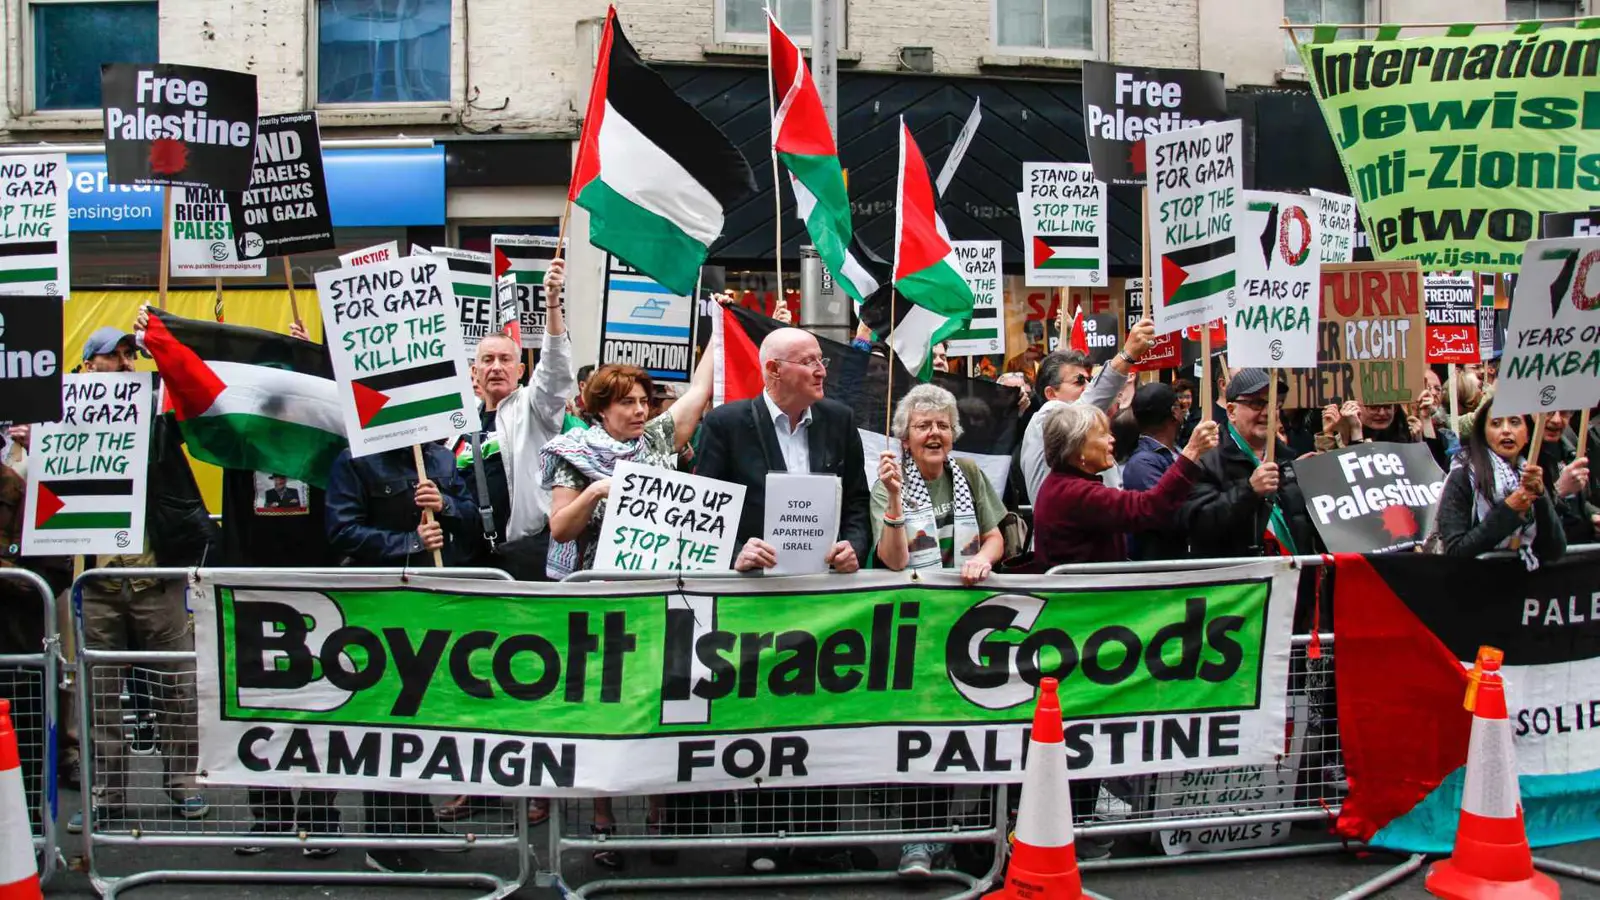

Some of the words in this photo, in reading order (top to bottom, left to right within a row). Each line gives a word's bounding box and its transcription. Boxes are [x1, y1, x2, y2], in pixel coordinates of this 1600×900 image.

[137, 71, 208, 106] Free
[1116, 72, 1182, 109] Free
[107, 108, 250, 147] Palestine
[280, 114, 312, 123] Campaign
[255, 130, 302, 164] ND
[1155, 137, 1211, 167] STAND
[1216, 132, 1234, 153] UP
[34, 162, 57, 178] UP
[1031, 169, 1077, 183] STAND
[1156, 166, 1190, 194] FOR
[1195, 156, 1234, 184] GAZA
[6, 181, 57, 198] GAZA
[185, 188, 224, 203] MAK
[242, 183, 314, 206] ATTACKS
[1031, 185, 1058, 200] FOR
[1062, 185, 1099, 200] GAZA
[20, 203, 56, 220] THE
[68, 204, 152, 221] ensington
[176, 204, 226, 221] RIGHT
[244, 207, 268, 226] ON
[273, 202, 318, 222] GAZA
[1033, 204, 1070, 218] STOP
[1073, 204, 1099, 218] THE
[1160, 194, 1202, 222] STOP
[1209, 187, 1234, 213] THE
[1342, 203, 1351, 215] UP
[1037, 219, 1095, 234] KILLING
[1166, 213, 1232, 245] KILLING
[1330, 216, 1350, 232] GAZA
[246, 239, 263, 248] PSC
[1247, 201, 1312, 271] 70
[1320, 233, 1333, 248] OP
[1335, 235, 1349, 249] THE
[981, 247, 996, 259] UP
[965, 261, 996, 274] GAZA
[330, 269, 403, 302] STAND
[411, 263, 437, 288] UP
[975, 278, 997, 291] THE
[1292, 281, 1311, 299] OF
[334, 300, 379, 324] FOR
[384, 285, 443, 313] GAZA
[1425, 288, 1473, 303] FREEDOM
[1235, 304, 1311, 334] NAKBA
[1425, 309, 1476, 323] PALESTINE
[342, 322, 398, 352] STOP
[404, 314, 446, 340] THE
[1345, 319, 1410, 360] RIGHT
[1432, 328, 1468, 343] الحرية
[1518, 326, 1576, 349] YEARS
[354, 338, 446, 372] KILLING
[604, 340, 689, 371] OCCUPATION
[1428, 343, 1475, 357] لفلسطين
[1507, 349, 1600, 381] NAKBA
[114, 382, 141, 402] UP
[1292, 362, 1355, 405] THEIR
[1359, 361, 1412, 404] WILL
[83, 404, 138, 425] GAZA
[41, 433, 89, 453] STOP
[95, 432, 136, 451] THE
[44, 455, 129, 476] KILLING
[1337, 452, 1404, 484] Free
[622, 473, 696, 502] STAND
[702, 490, 732, 513] UP
[788, 500, 812, 509] STOP
[616, 496, 658, 525] FOR
[664, 507, 725, 539] GAZA
[779, 514, 819, 524] ARMING
[772, 528, 824, 537] APARTHEID
[613, 526, 670, 552] STOP
[677, 537, 719, 563] THE
[782, 542, 813, 551] ISRAEL
[231, 590, 637, 717] Boycott
[659, 594, 920, 726] Israeli
[946, 593, 1246, 711] Goods
[237, 726, 576, 788] CAMPAIGN
[677, 737, 809, 783] FOR
[896, 715, 1241, 773] PALSTINE
[1179, 765, 1264, 787] KILLING
[1169, 829, 1192, 846] UP
[1198, 823, 1262, 845] STAND
